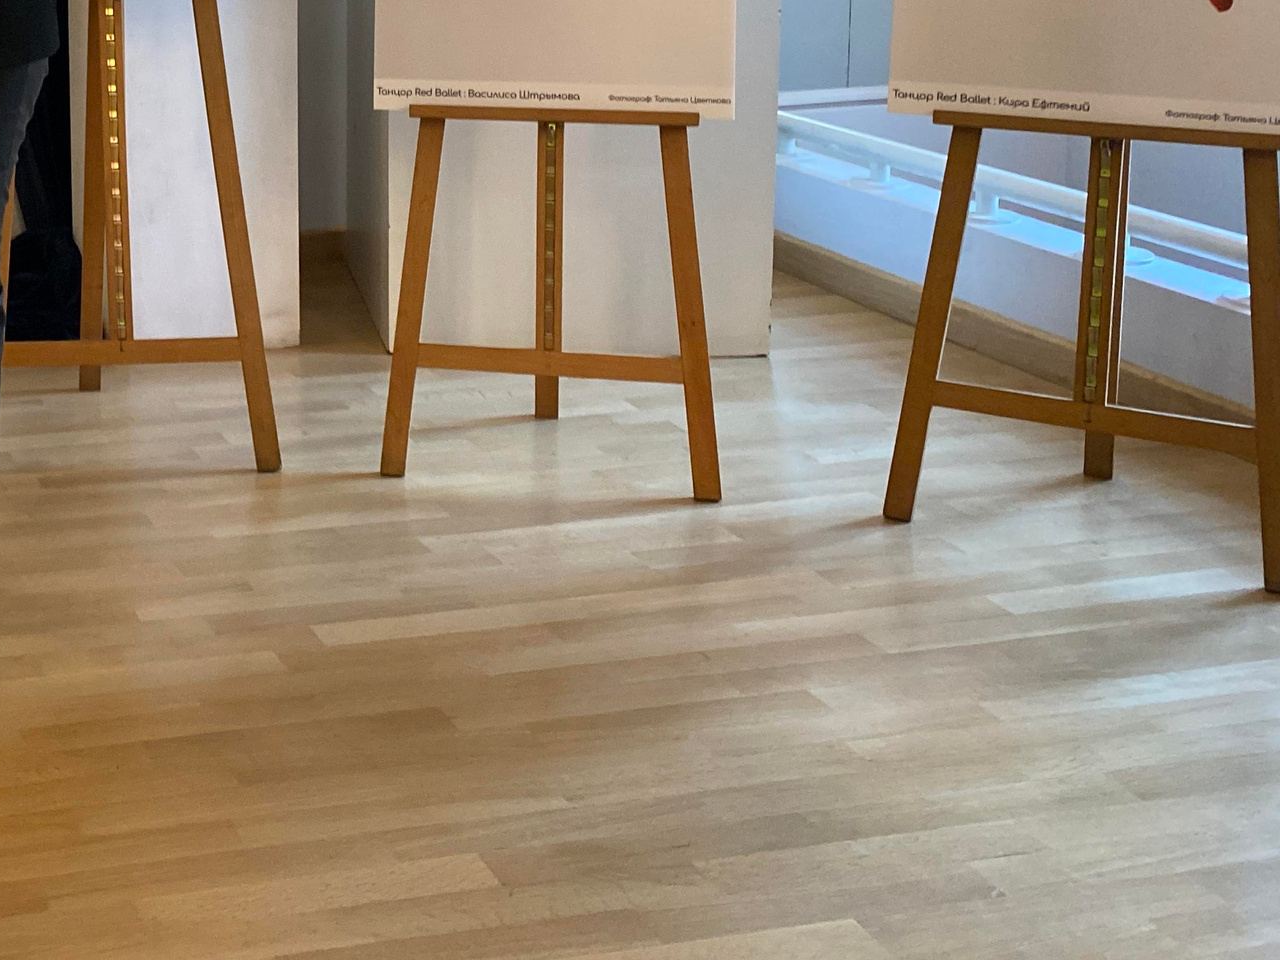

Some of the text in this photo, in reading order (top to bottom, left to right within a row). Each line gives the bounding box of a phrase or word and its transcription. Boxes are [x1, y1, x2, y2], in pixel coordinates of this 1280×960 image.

[377, 87, 413, 98] Танцор
[415, 88, 433, 97] Red
[435, 88, 462, 98] Ballet
[468, 89, 517, 99] Василиса
[519, 90, 581, 102] Штрымова
[893, 89, 934, 102] Танцор
[936, 91, 957, 102] Red
[960, 93, 991, 104] Ballet
[999, 96, 1030, 108] Кира
